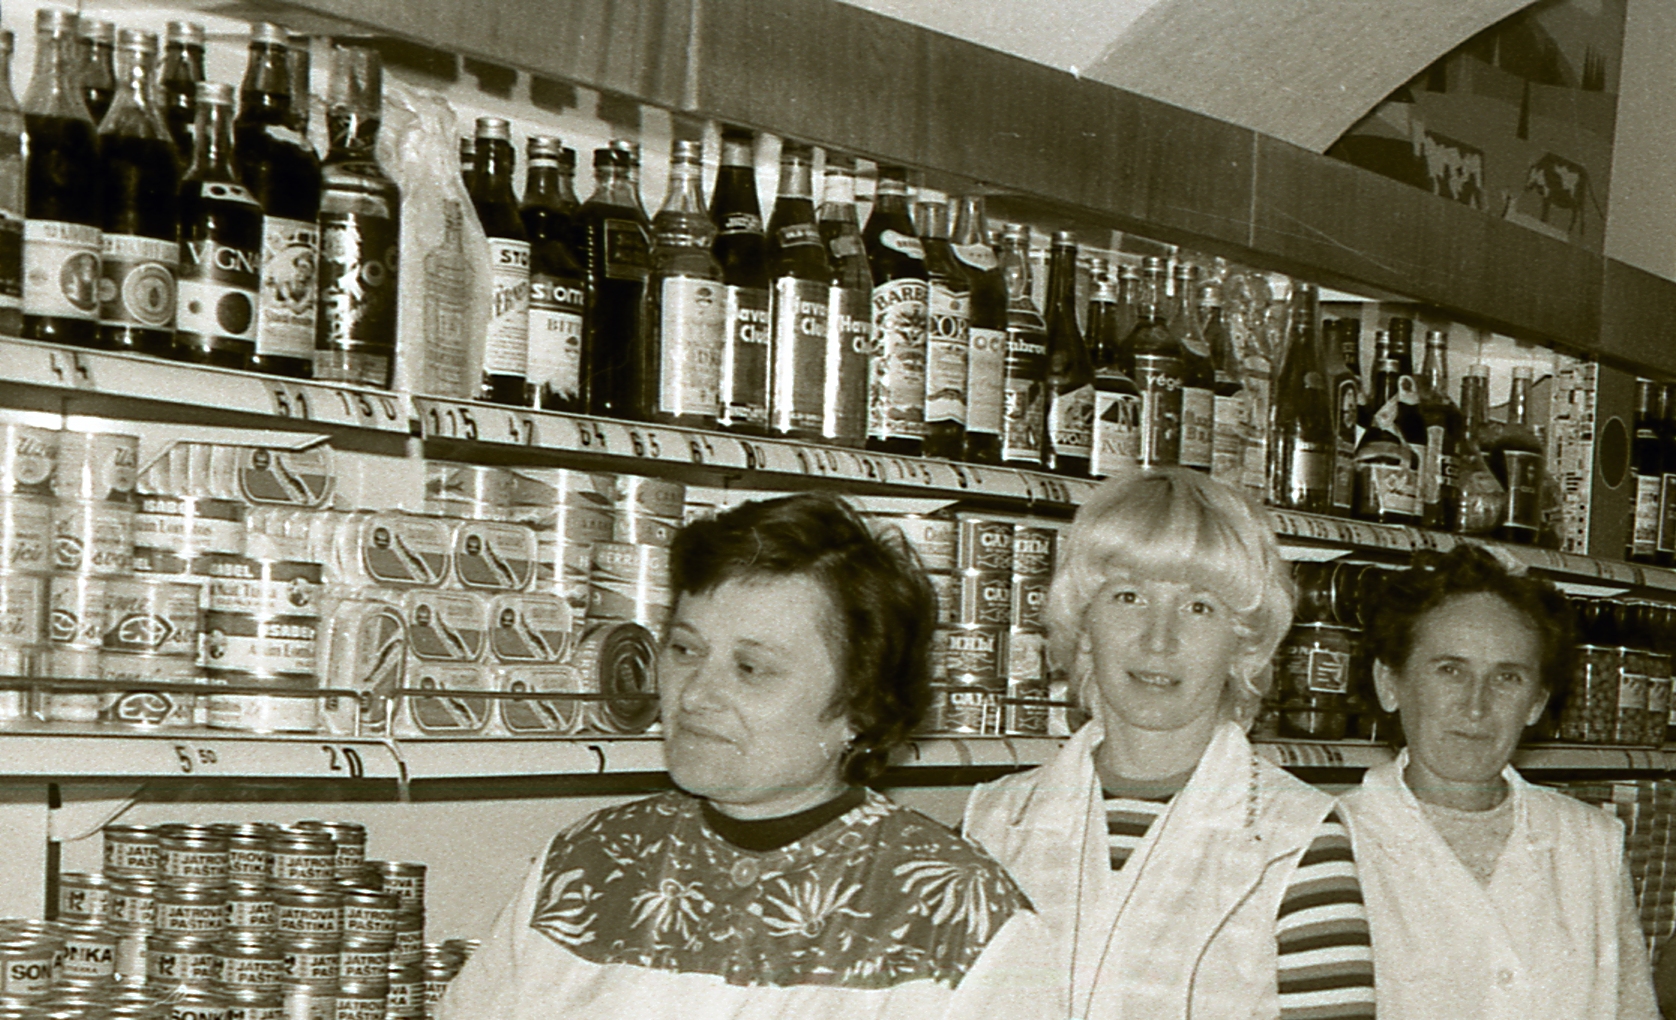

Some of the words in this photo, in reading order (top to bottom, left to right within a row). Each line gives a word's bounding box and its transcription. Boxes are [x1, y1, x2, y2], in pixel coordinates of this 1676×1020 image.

[187, 241, 260, 275] VGN
[280, 909, 335, 919] JATROVA
[280, 919, 335, 931] PAŠTIKA
